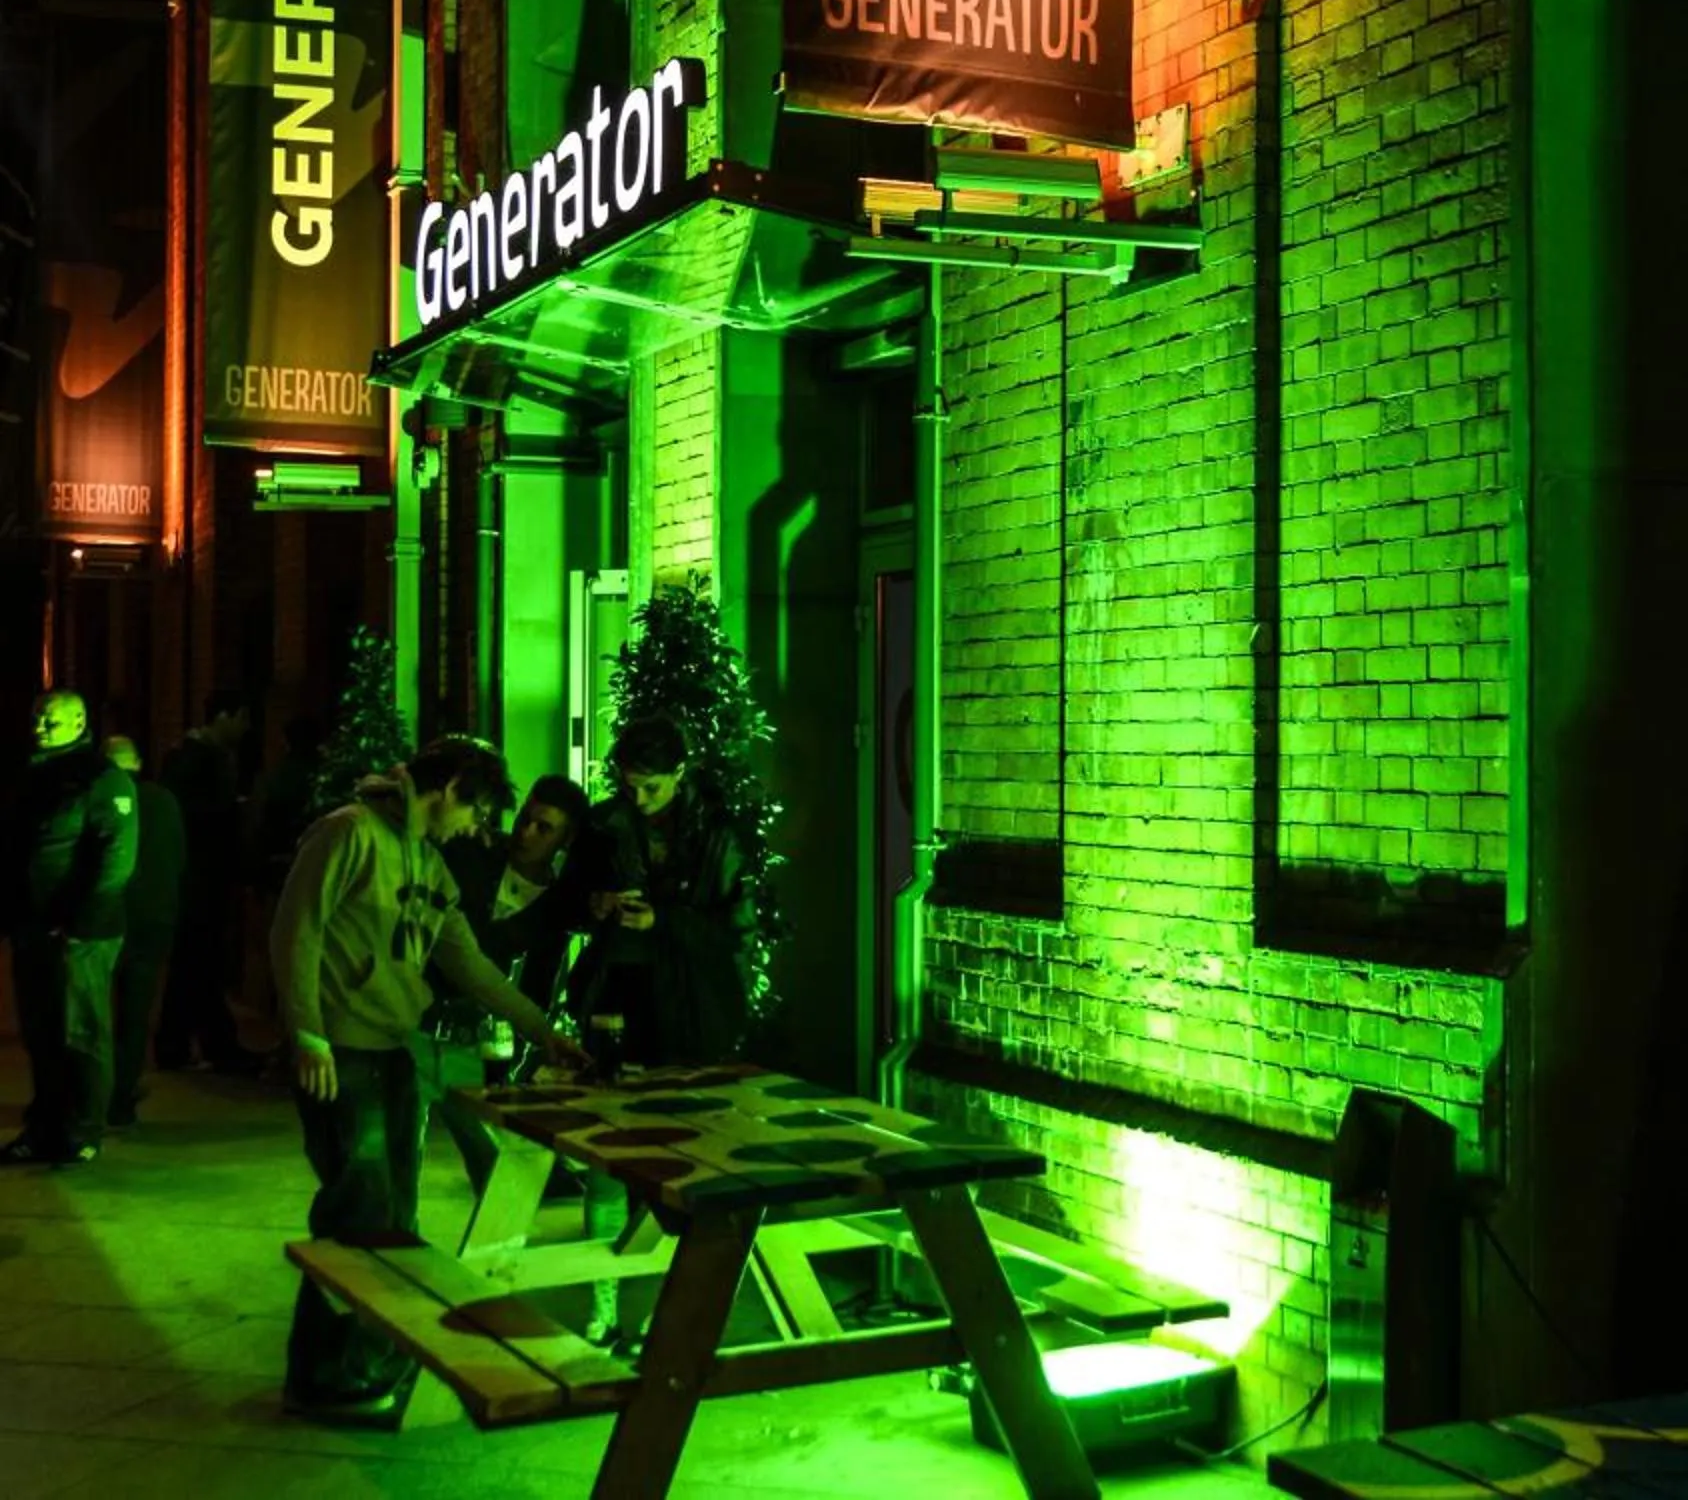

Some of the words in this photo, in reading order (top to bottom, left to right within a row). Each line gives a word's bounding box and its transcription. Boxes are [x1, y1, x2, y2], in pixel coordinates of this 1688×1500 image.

[415, 58, 684, 325] Generator
[225, 363, 373, 417] GENERATOR
[50, 481, 151, 515] GENERATOR
